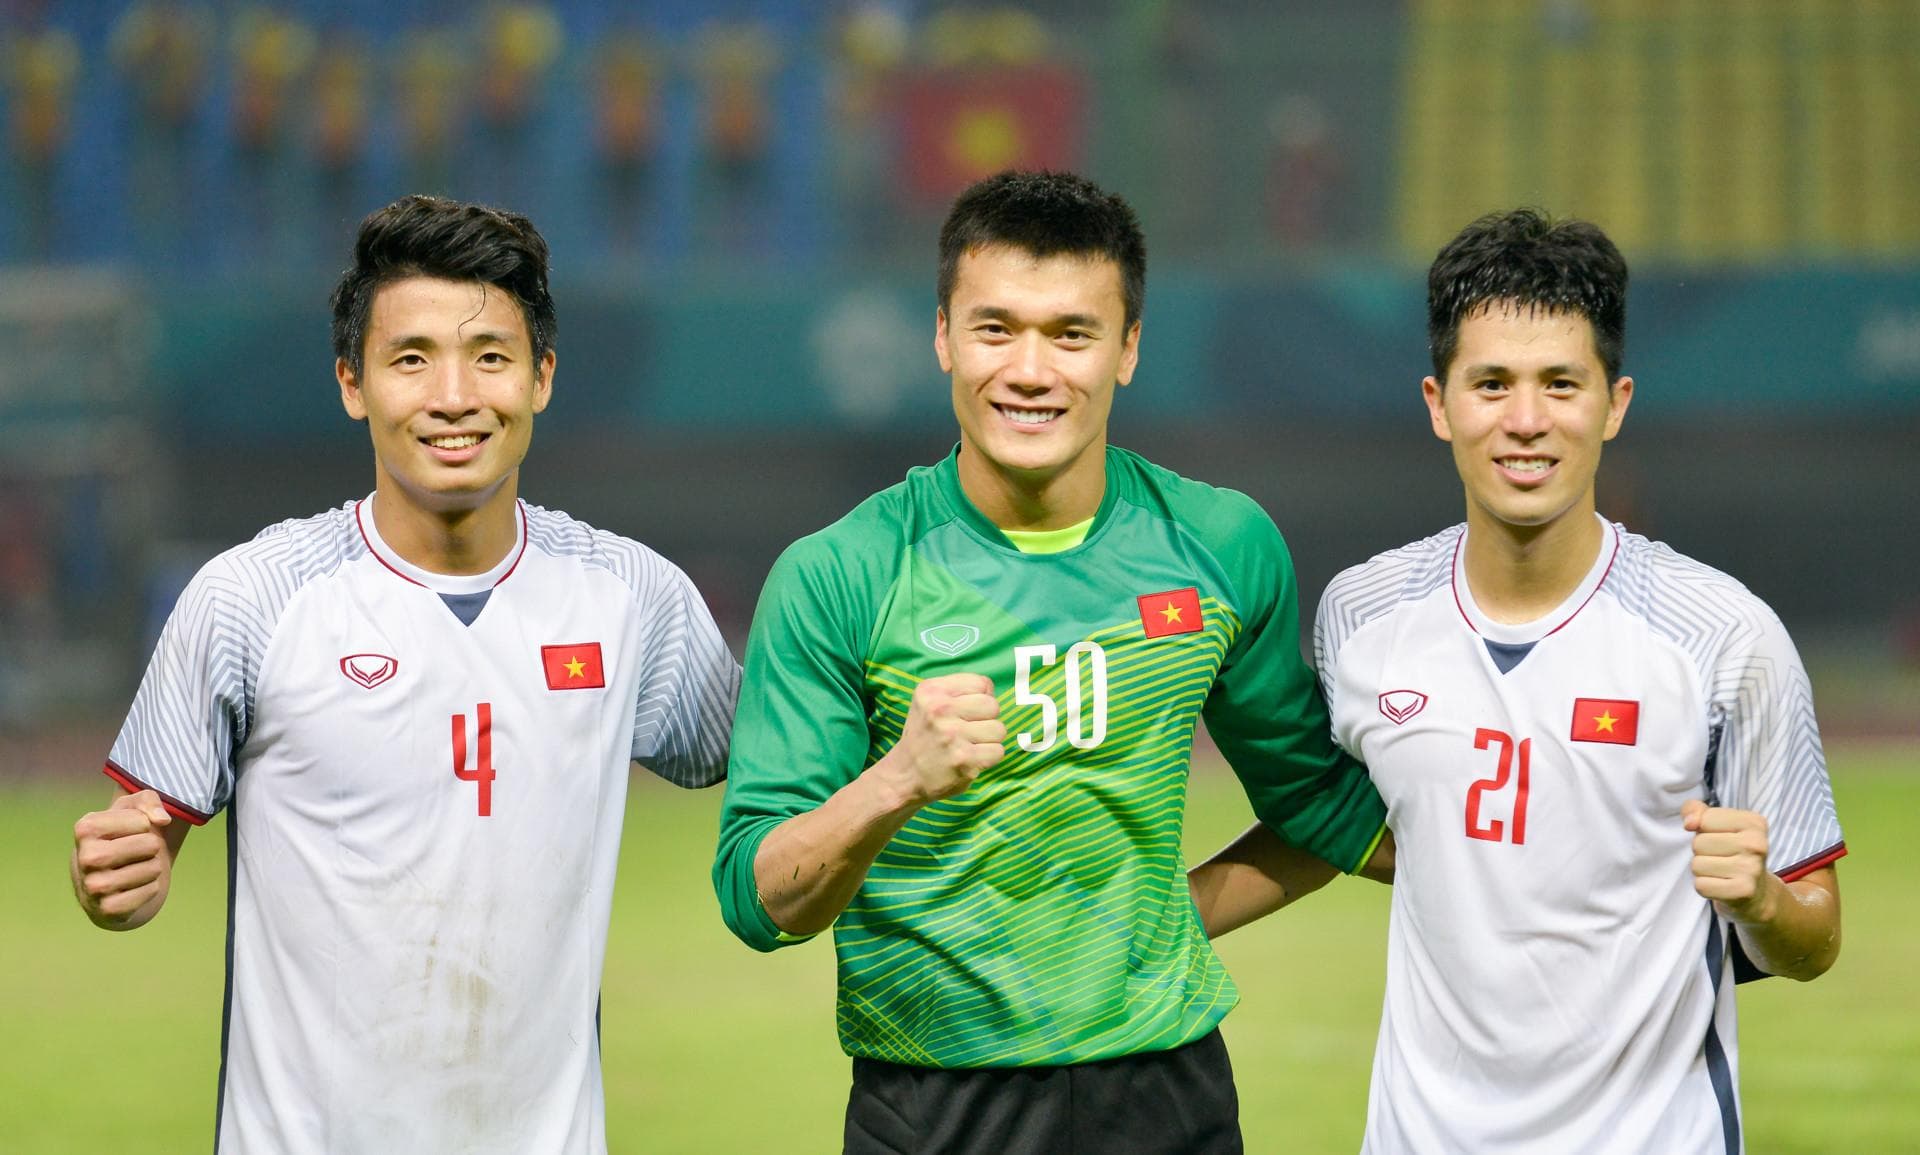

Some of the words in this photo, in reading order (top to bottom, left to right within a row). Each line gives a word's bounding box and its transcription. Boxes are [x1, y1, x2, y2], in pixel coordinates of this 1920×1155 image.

[1013, 640, 1108, 753] 50
[451, 702, 497, 817] 4
[1465, 727, 1531, 846] 21
